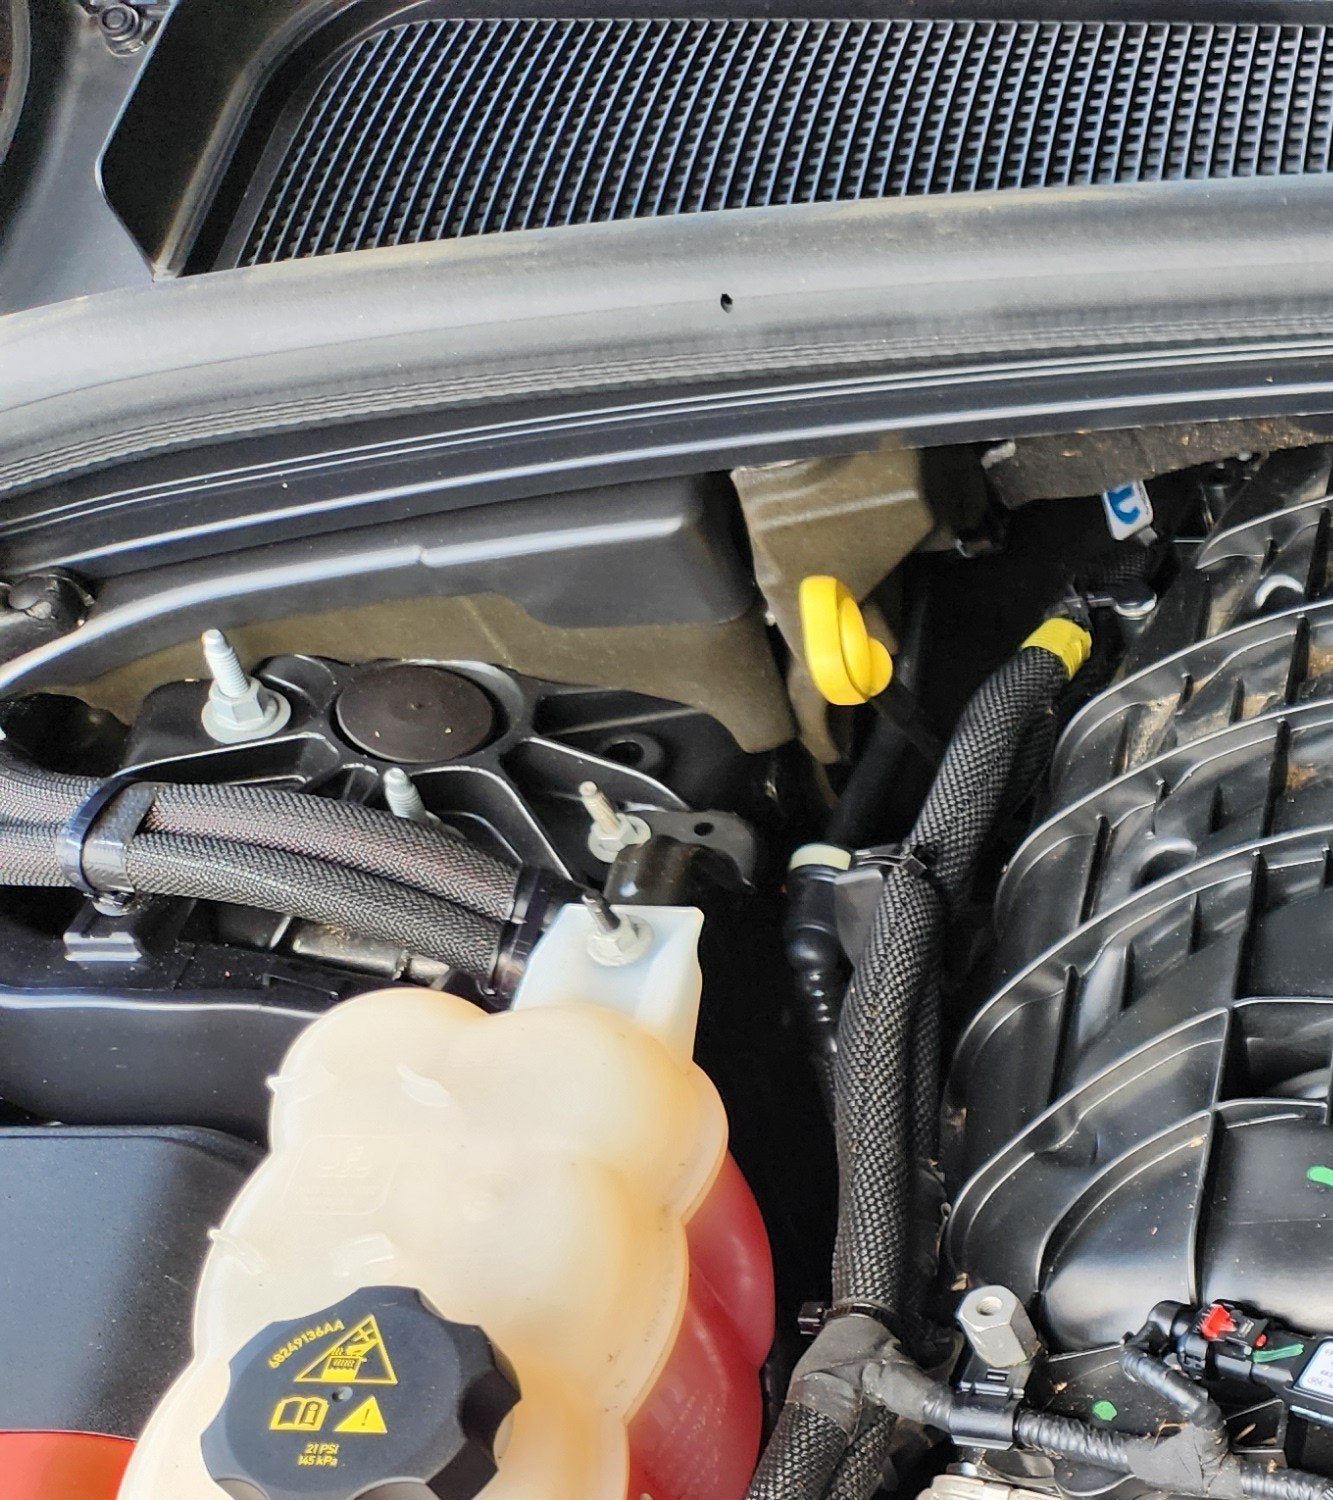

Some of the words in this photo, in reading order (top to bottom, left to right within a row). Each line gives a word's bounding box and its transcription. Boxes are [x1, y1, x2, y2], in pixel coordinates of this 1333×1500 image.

[306, 1443, 318, 1454] 21
[318, 1443, 340, 1454] PSI
[297, 1456, 315, 1467] 145
[316, 1456, 338, 1468] kPa
